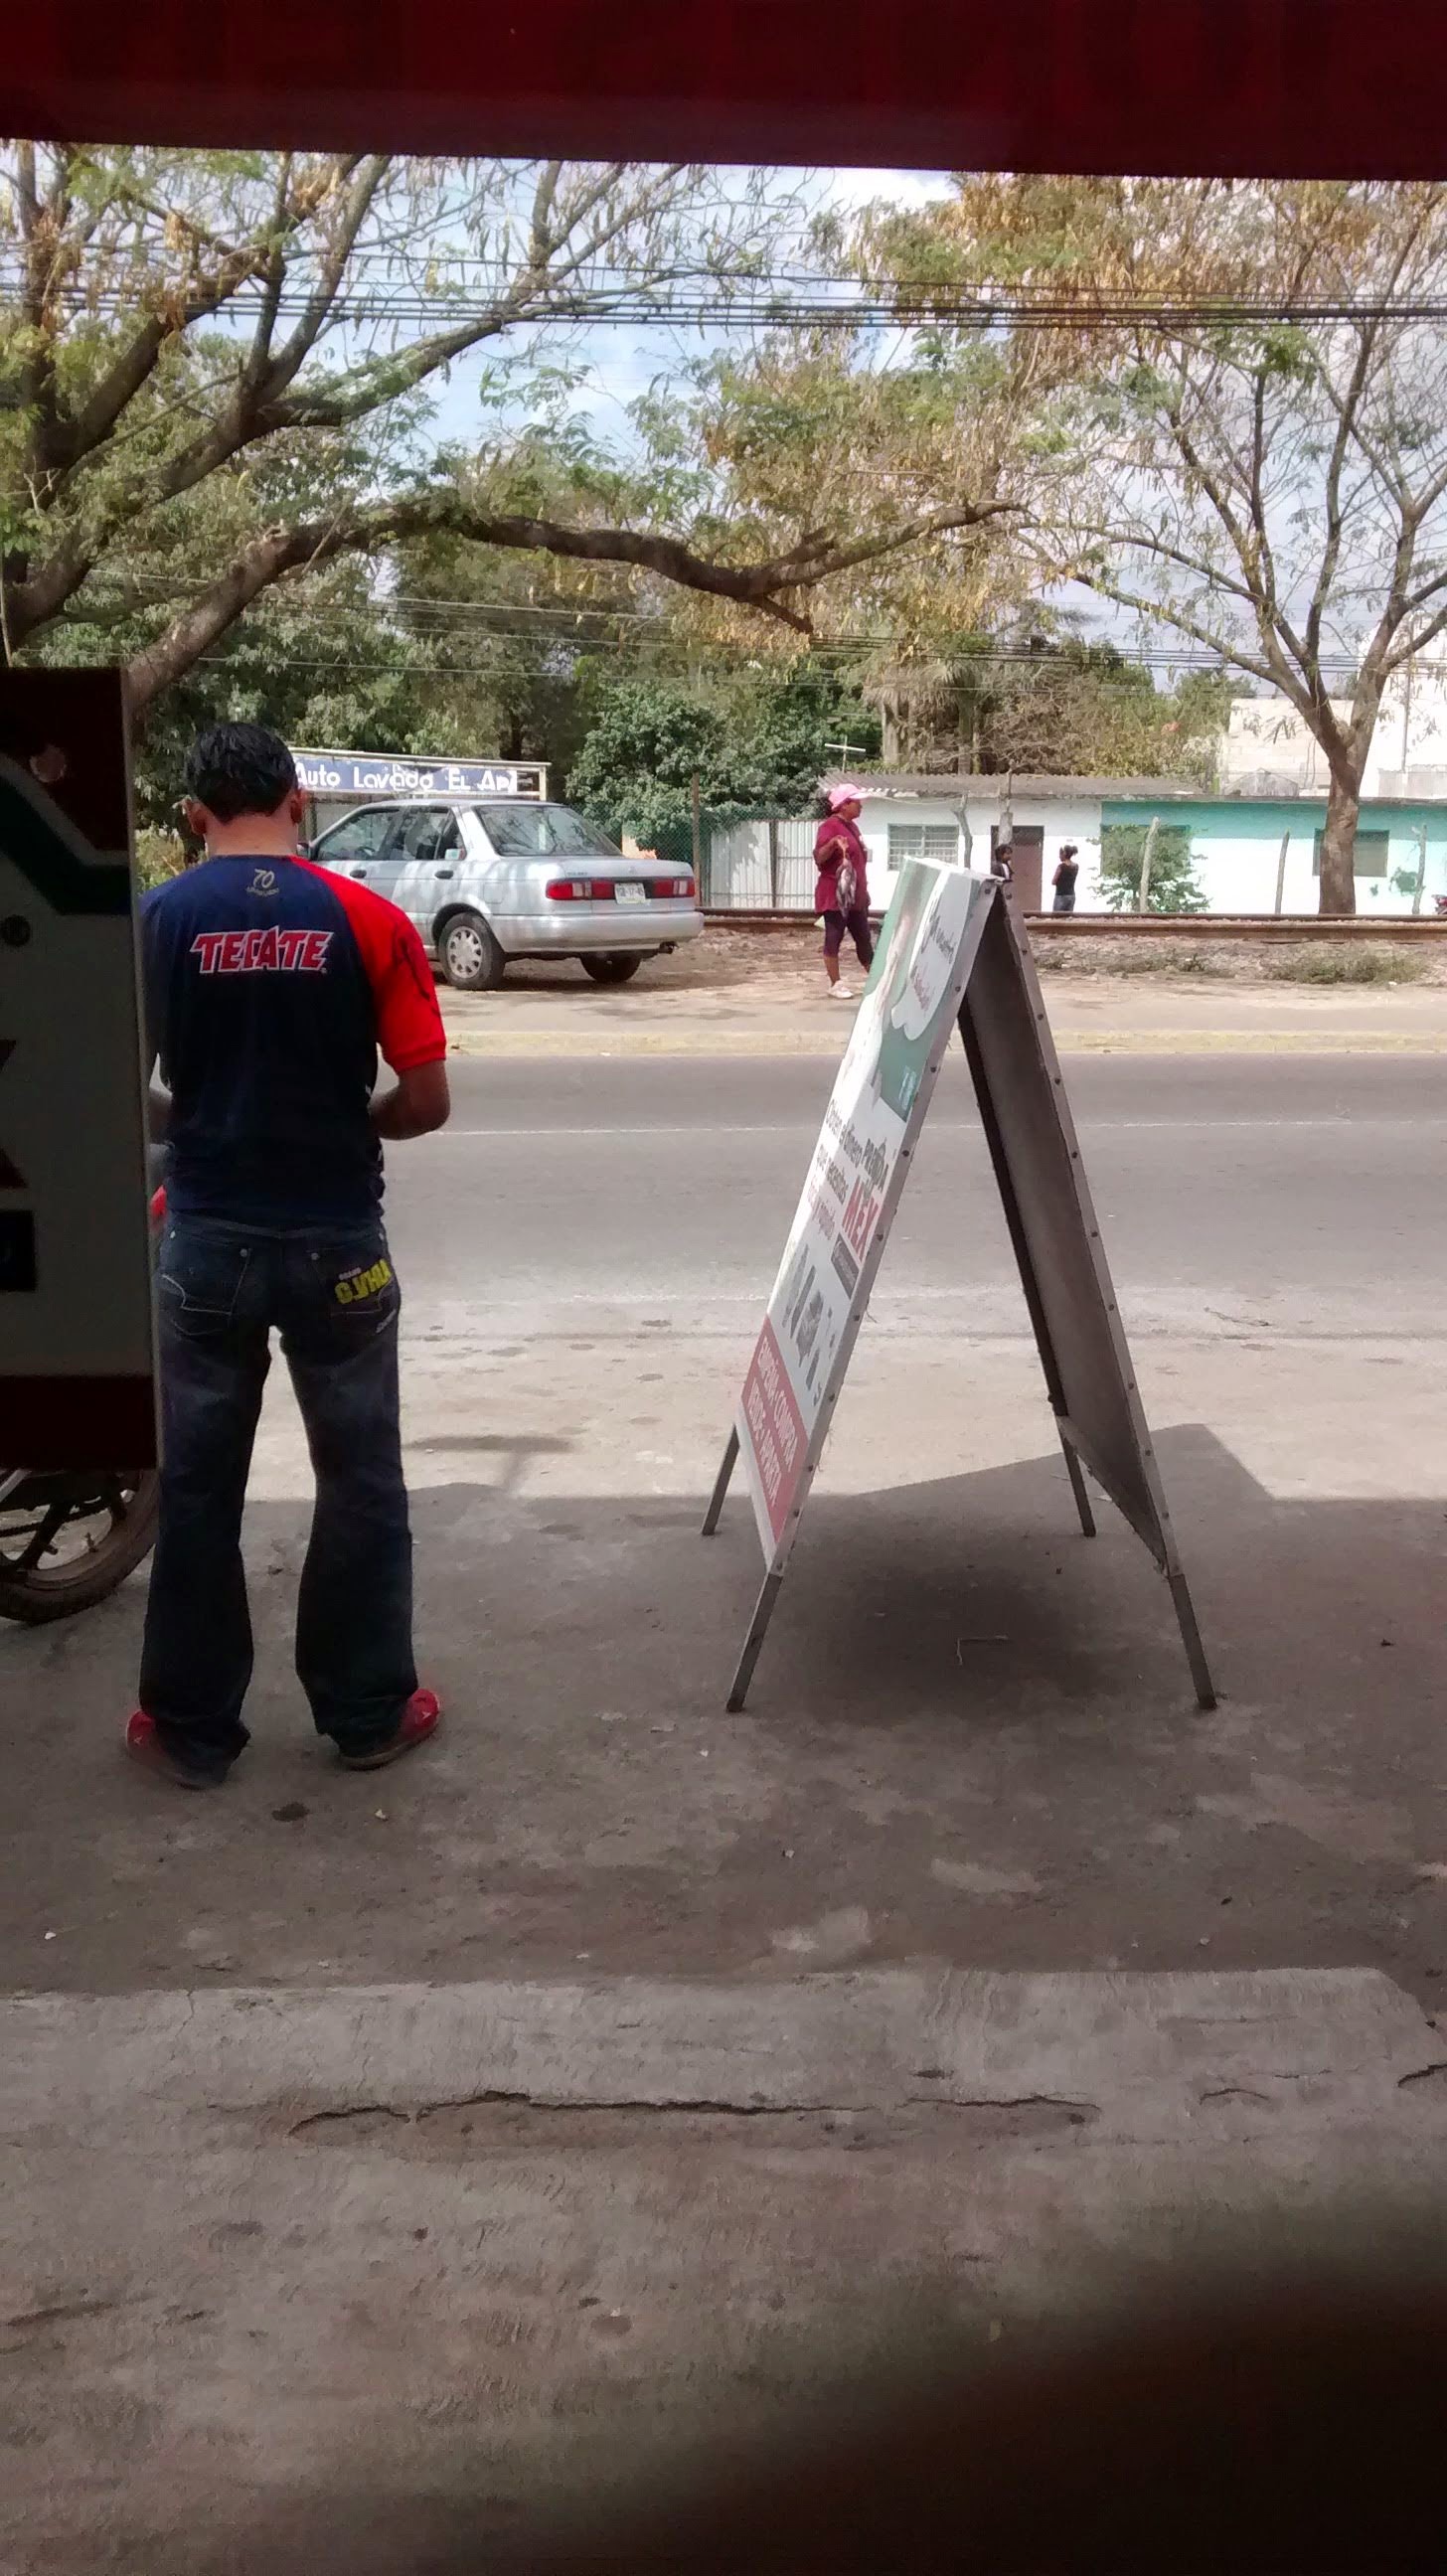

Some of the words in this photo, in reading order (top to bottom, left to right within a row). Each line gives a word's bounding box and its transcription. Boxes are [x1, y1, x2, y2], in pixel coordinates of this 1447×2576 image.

[295, 762, 341, 787] Auto
[354, 764, 434, 790] Lavado
[253, 868, 275, 888] 70
[190, 925, 334, 973] TECATE
